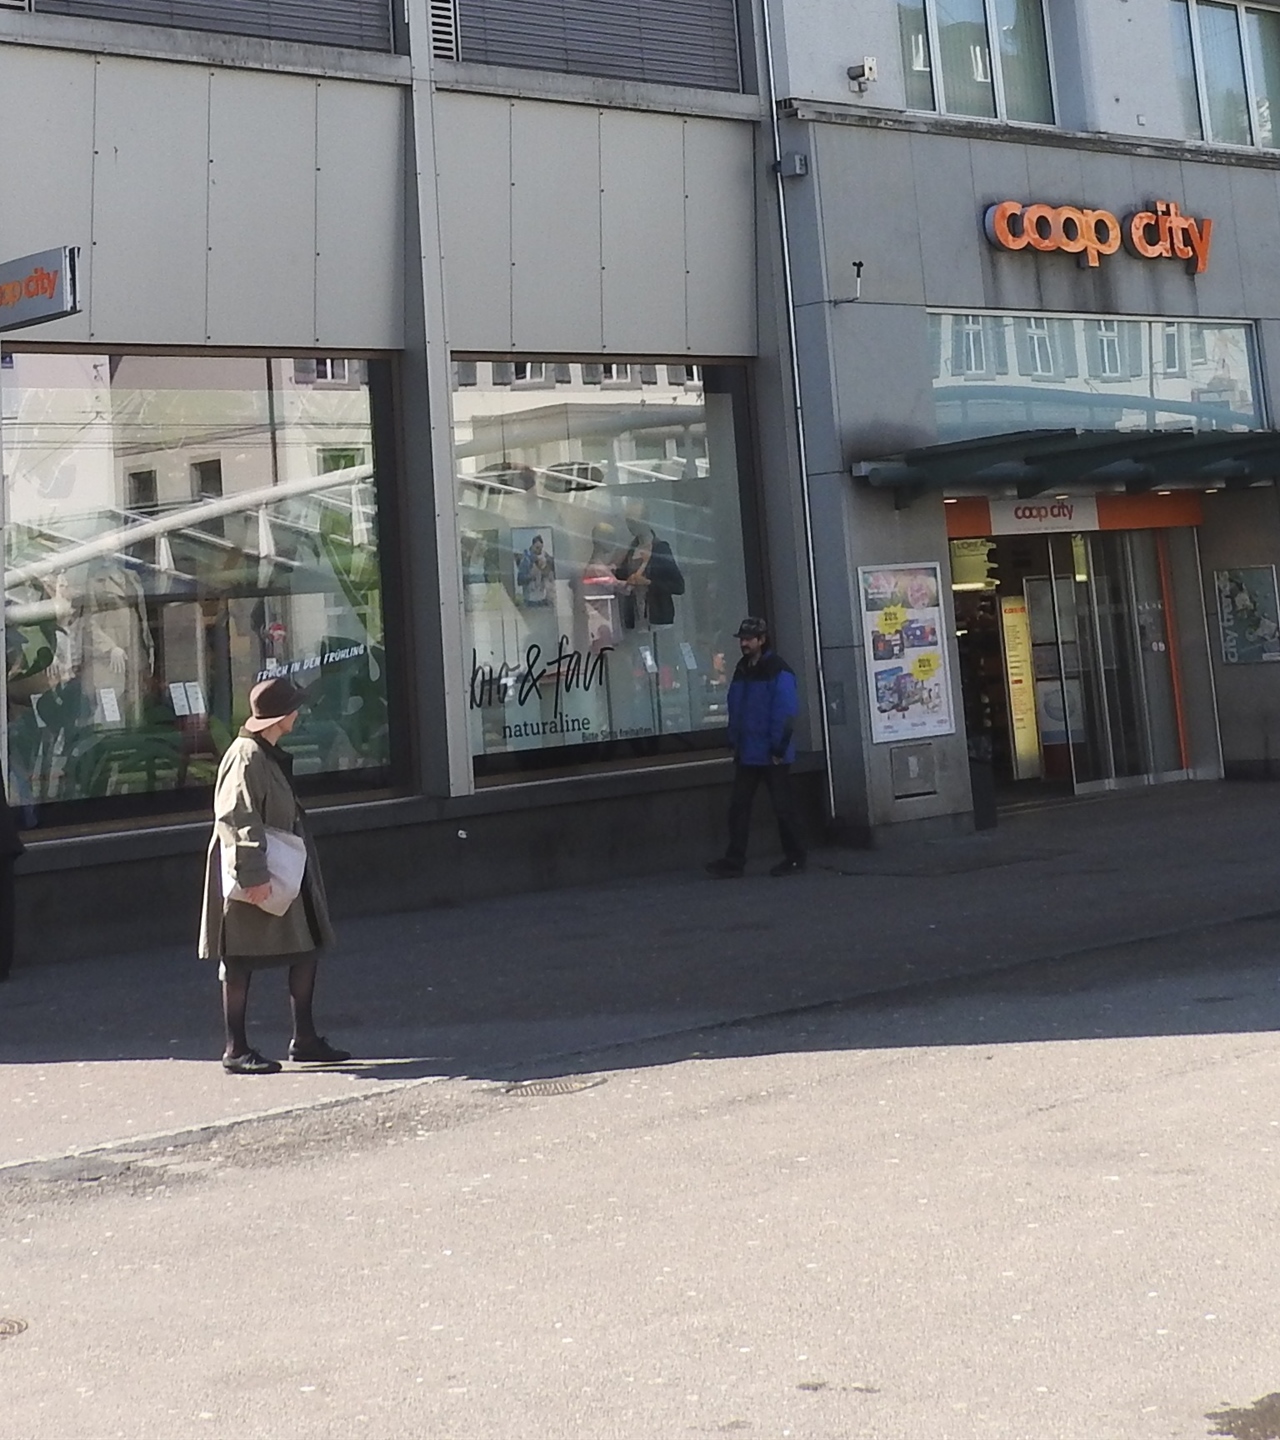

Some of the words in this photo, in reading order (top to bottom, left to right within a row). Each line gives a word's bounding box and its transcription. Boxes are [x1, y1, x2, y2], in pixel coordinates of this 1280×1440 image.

[992, 200, 1122, 268] coop
[1131, 199, 1213, 274] city
[23, 266, 59, 300] city
[1014, 504, 1049, 522] coop
[1050, 500, 1074, 520] city
[290, 661, 301, 673] IN
[303, 656, 321, 670] DEN
[323, 644, 365, 665] FRÜHLING
[1224, 629, 1239, 663] city
[470, 646, 521, 710] bio
[518, 644, 547, 707] &
[502, 713, 591, 739] naturaline
